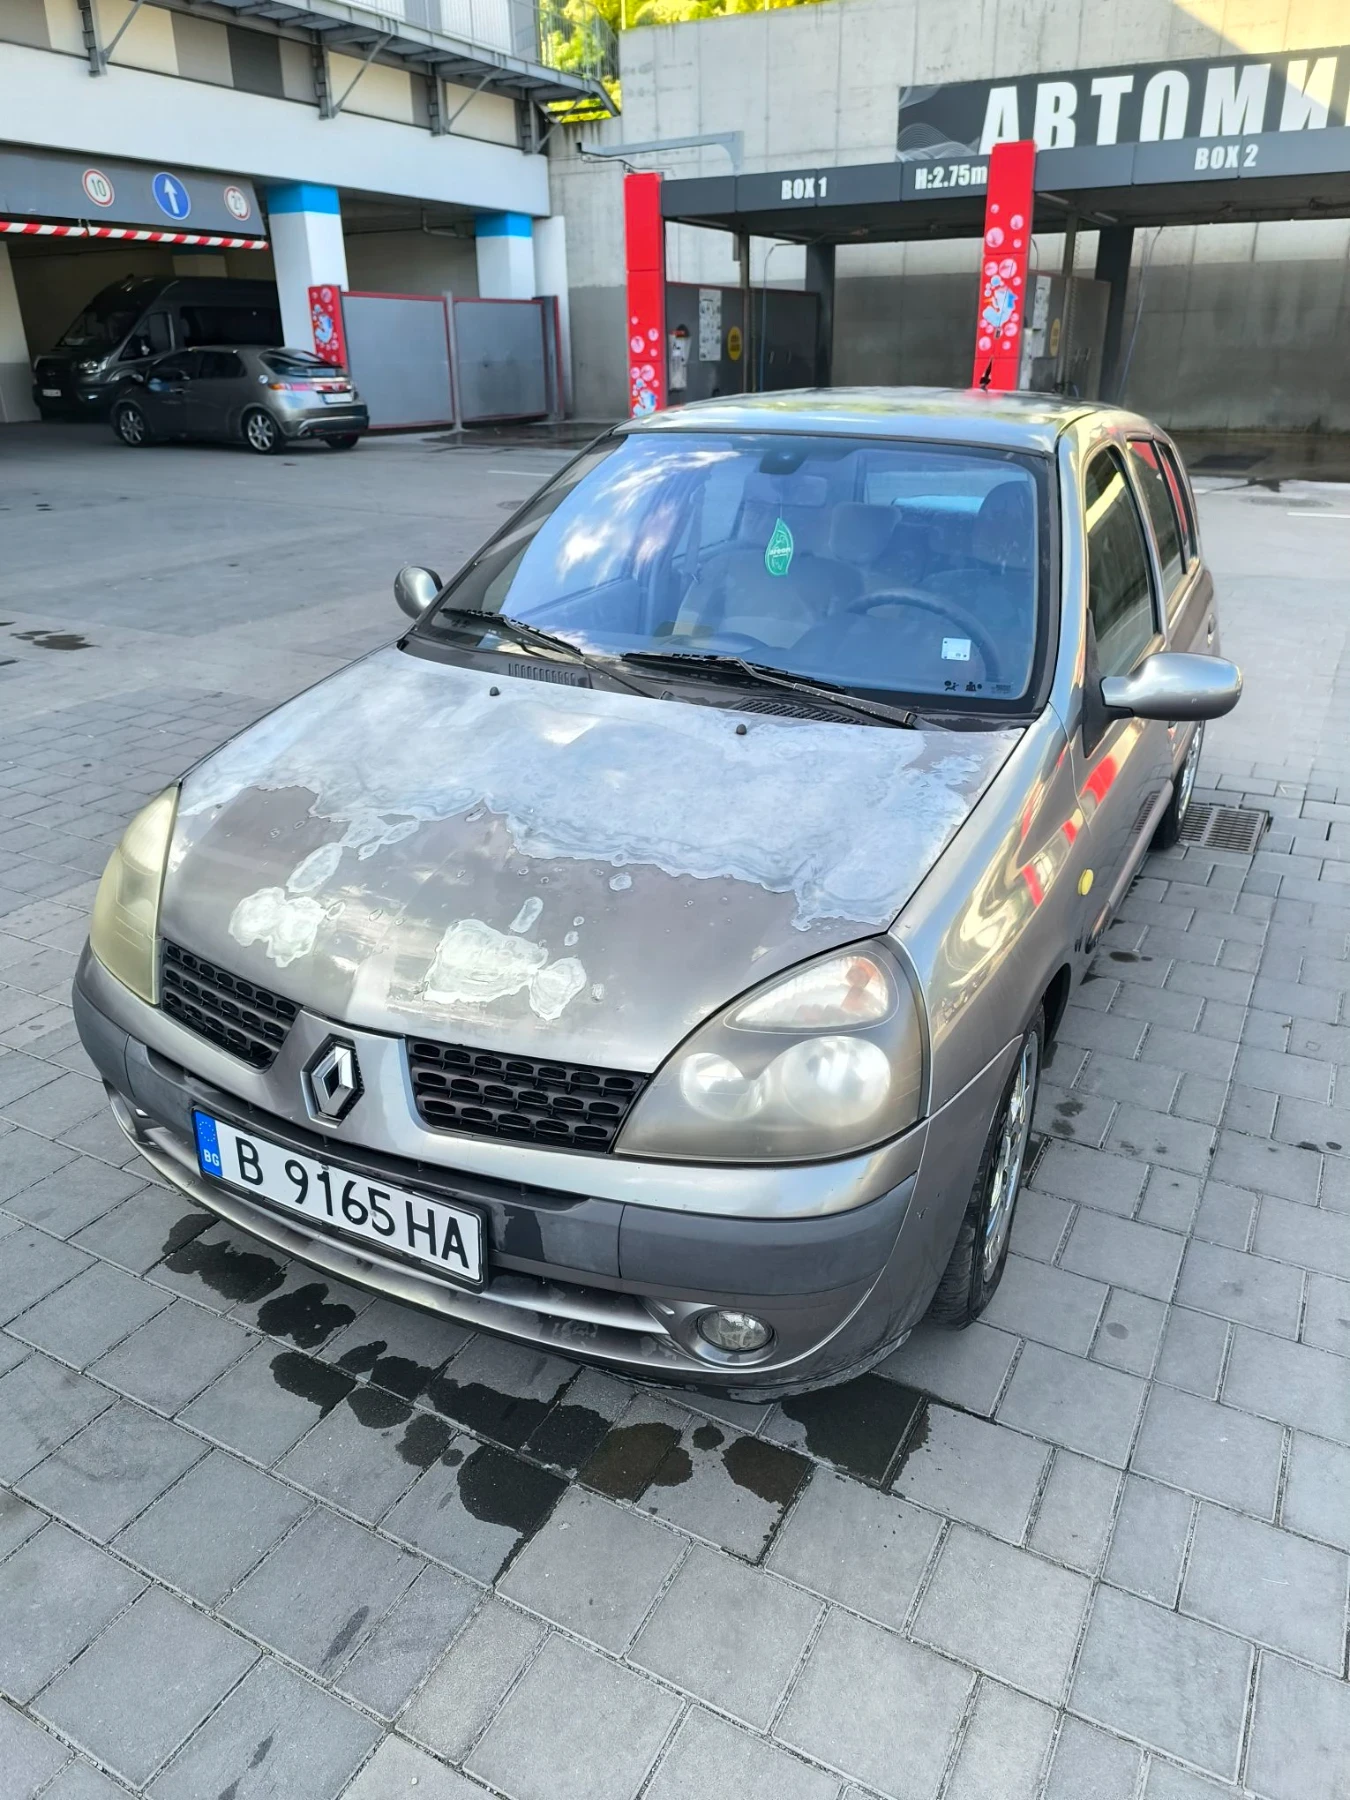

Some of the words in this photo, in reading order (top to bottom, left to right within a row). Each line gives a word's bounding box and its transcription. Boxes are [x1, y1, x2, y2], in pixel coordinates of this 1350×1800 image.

[978, 56, 1350, 155] АВТОМИ
[1194, 144, 1240, 171] BOX
[1243, 143, 1259, 168] 2
[91, 179, 107, 197] 10
[781, 177, 815, 200] BOX
[818, 176, 828, 198] 1
[914, 163, 988, 190] H:2.75m
[203, 1148, 220, 1167] BG
[235, 1136, 264, 1186] B
[284, 1159, 396, 1237] 9165
[405, 1201, 470, 1269] HA
